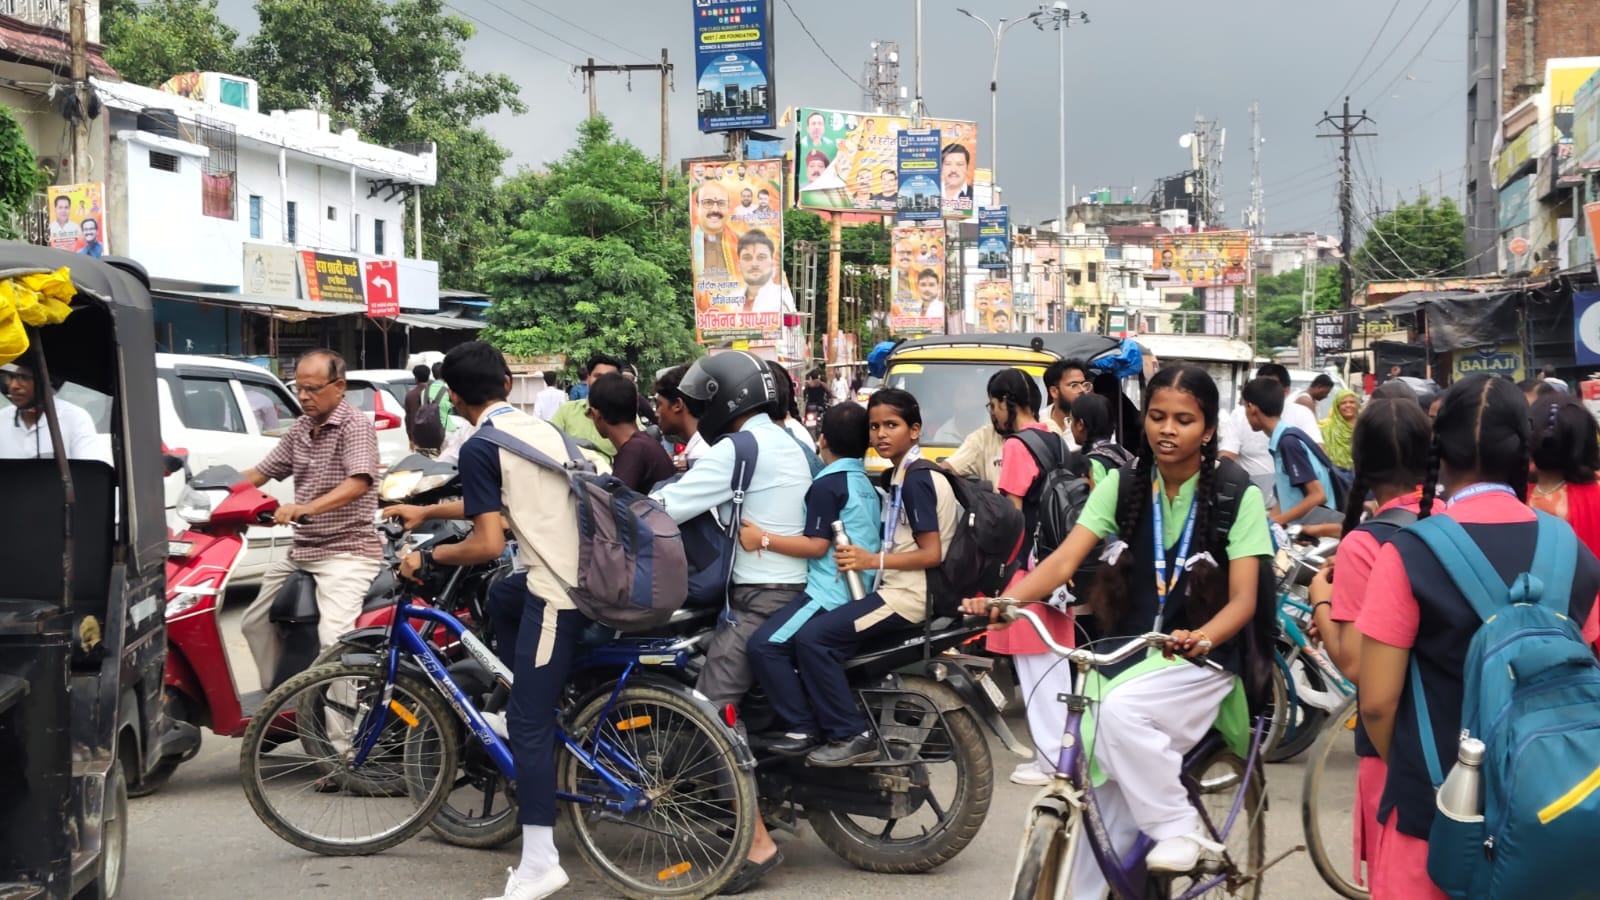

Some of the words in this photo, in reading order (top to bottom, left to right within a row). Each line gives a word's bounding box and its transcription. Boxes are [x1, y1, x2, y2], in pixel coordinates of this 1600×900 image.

[701, 5, 757, 16] ADMISSIONS
[718, 15, 741, 24] OPEN
[698, 309, 736, 328] अभिनव
[738, 312, 779, 328] उपाध्याय
[1460, 358, 1515, 371] BALAJI
[417, 651, 441, 673] 26
